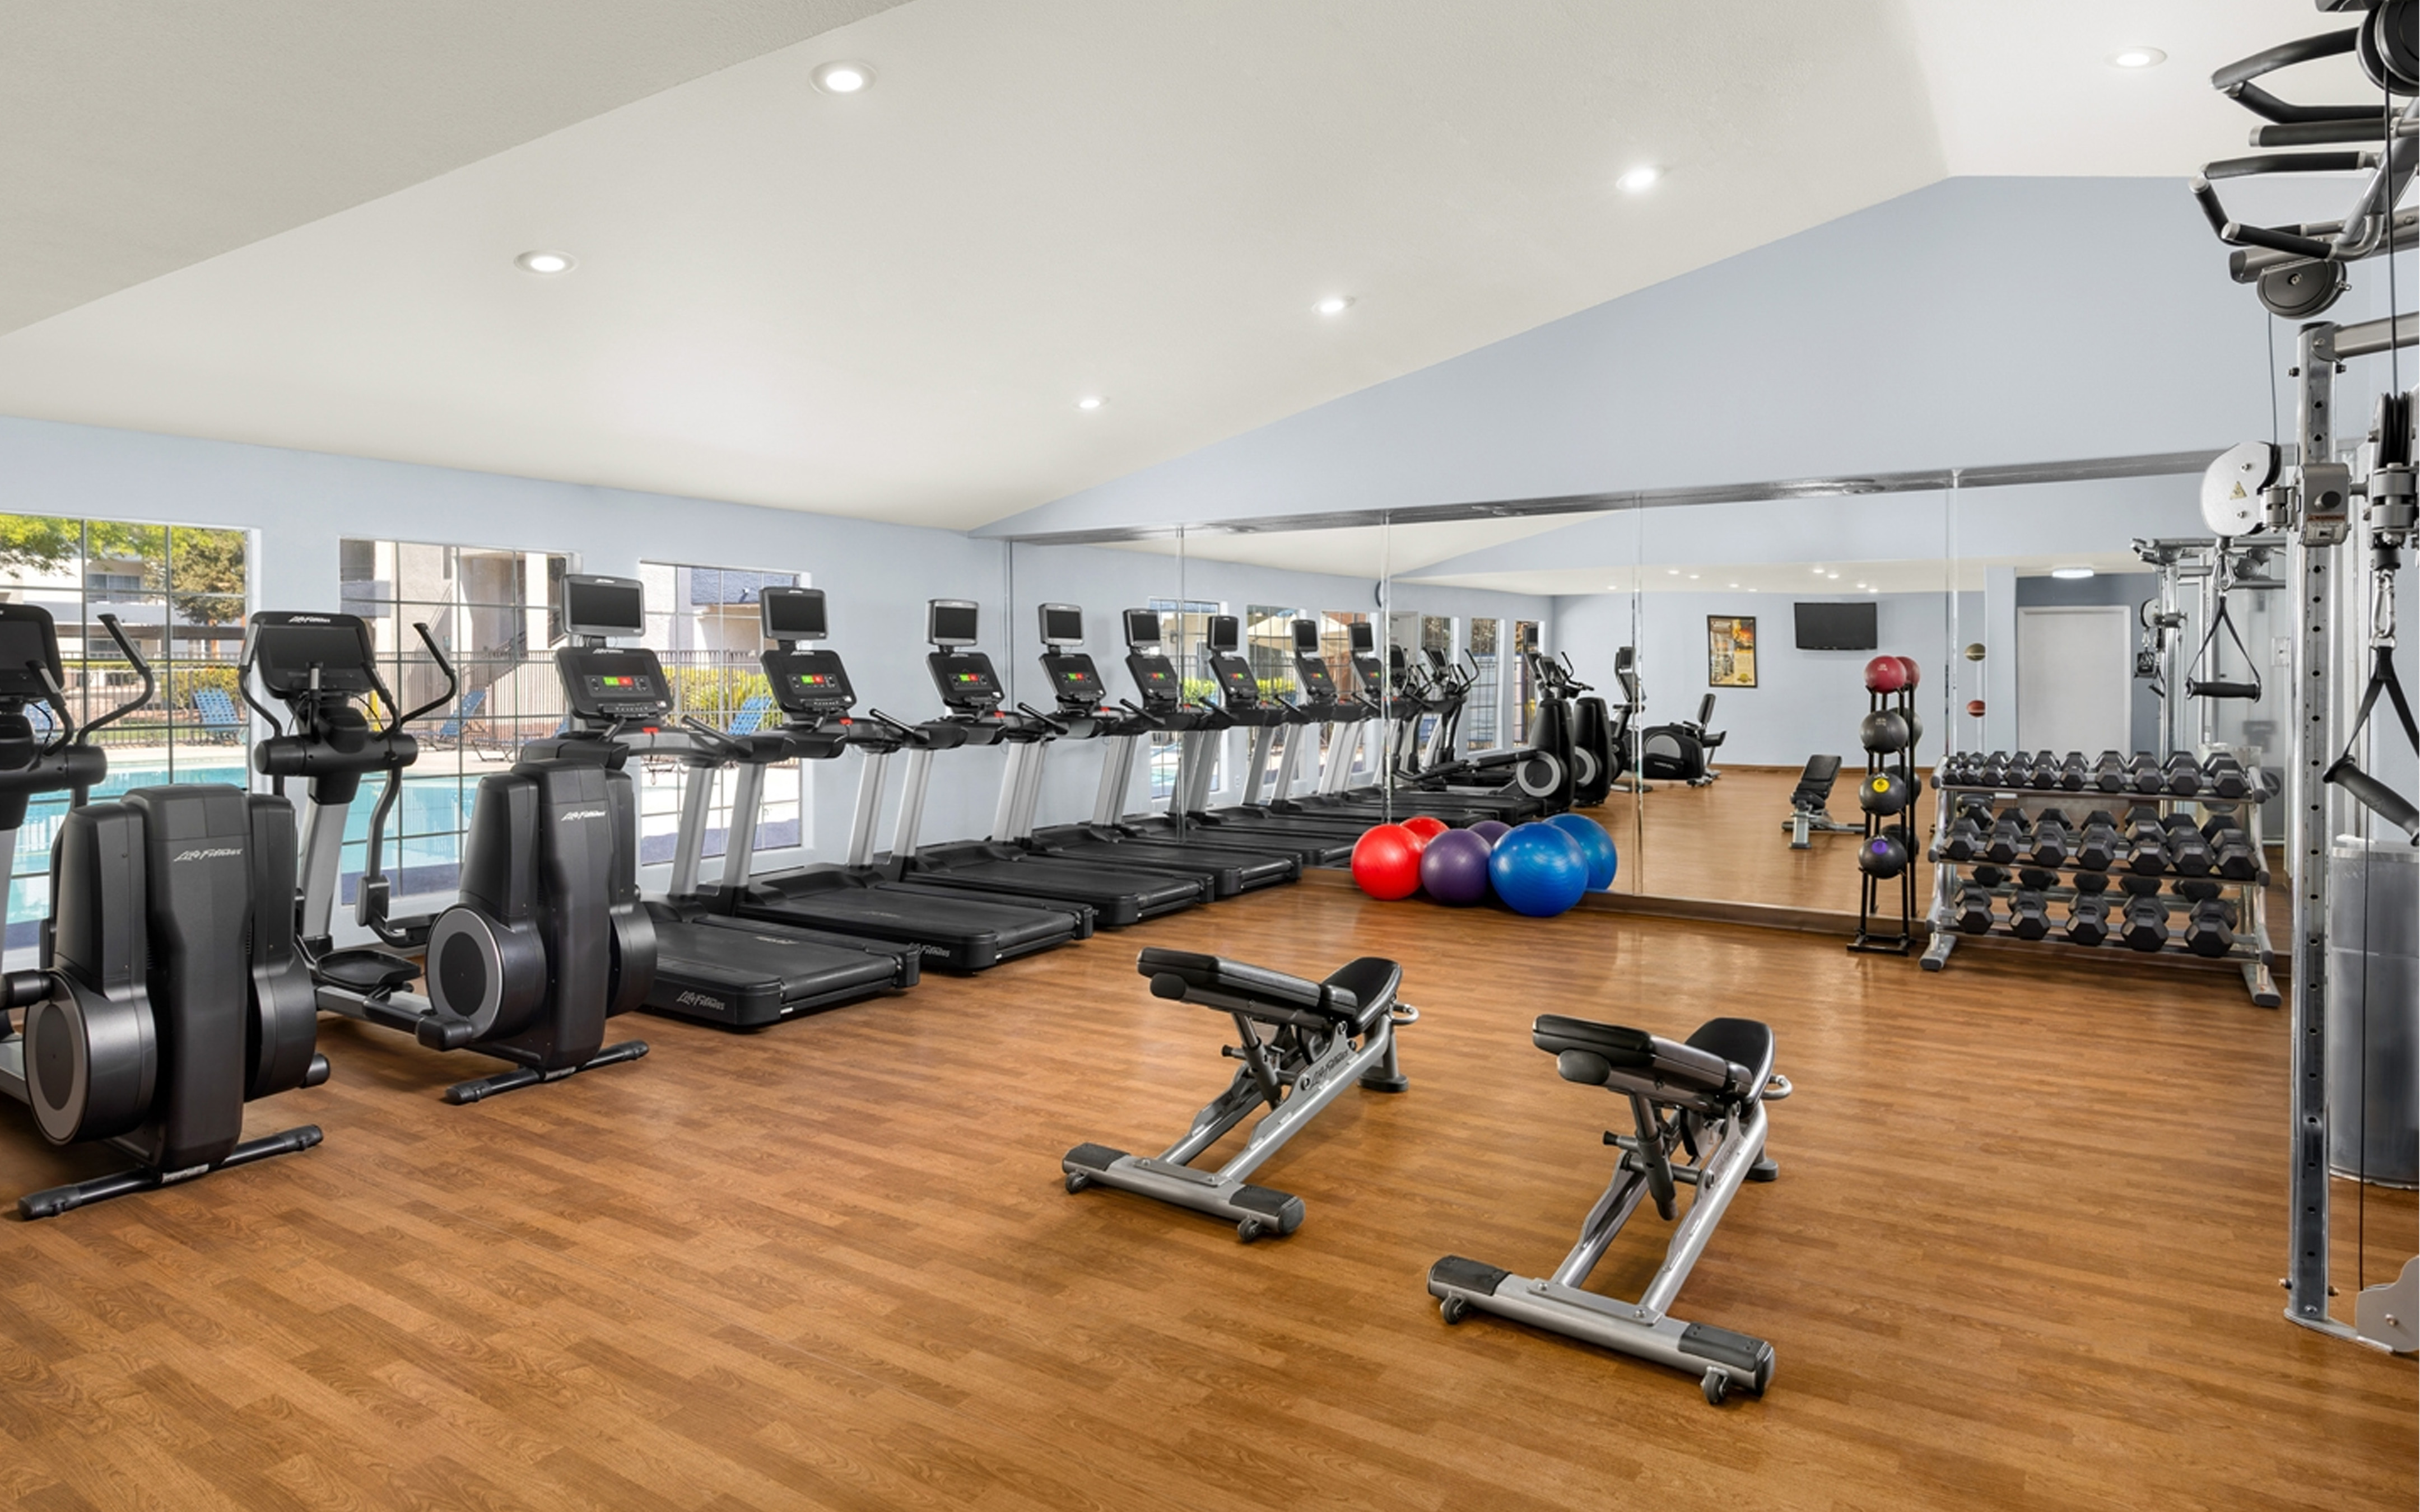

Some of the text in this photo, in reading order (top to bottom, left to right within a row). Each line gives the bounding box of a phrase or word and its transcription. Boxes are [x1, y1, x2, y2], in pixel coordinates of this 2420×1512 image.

[173, 850, 201, 862] Life
[676, 991, 725, 1010] Life Fitness
